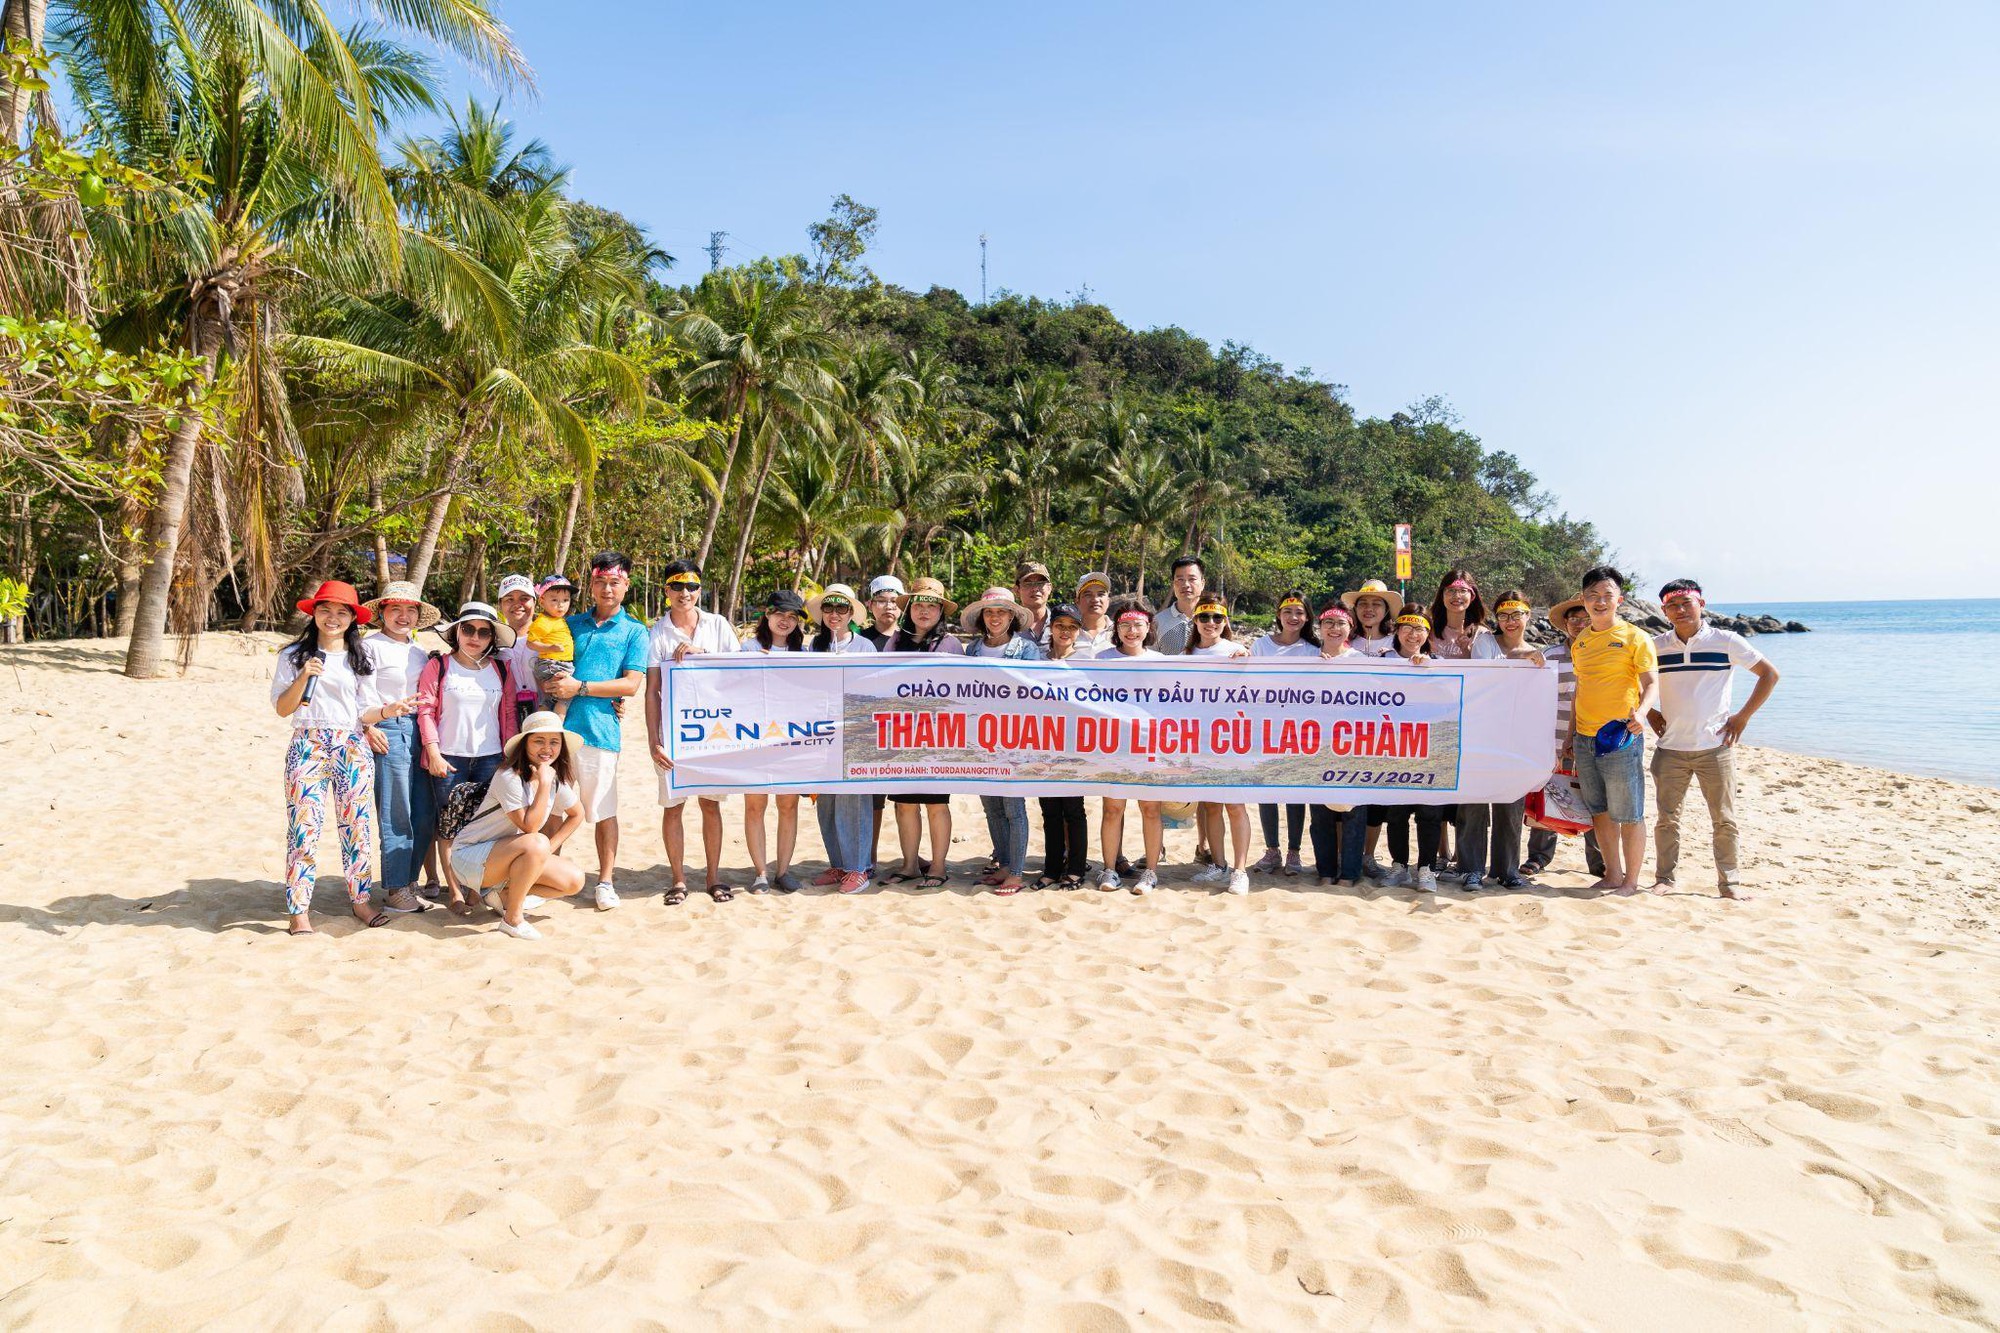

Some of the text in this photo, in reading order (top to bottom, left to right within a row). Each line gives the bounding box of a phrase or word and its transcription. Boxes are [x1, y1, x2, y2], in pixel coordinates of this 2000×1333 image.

[896, 679, 1406, 708] CHÀO MỪNG ĐOÀN CÔNG TY ĐẦU TƯ XÂY DỰNG DACINCO
[680, 708, 731, 719] TOUR
[803, 738, 836, 746] CITY
[872, 711, 1429, 763] THAM QUAN DU LỊCH CÙ LAO CHÀM
[850, 766, 868, 775] ĐƠN
[870, 766, 878, 777] VỊ
[930, 766, 1011, 776] TOURDANANGCITY.VN
[1322, 770, 1436, 785] 07/3/2021
